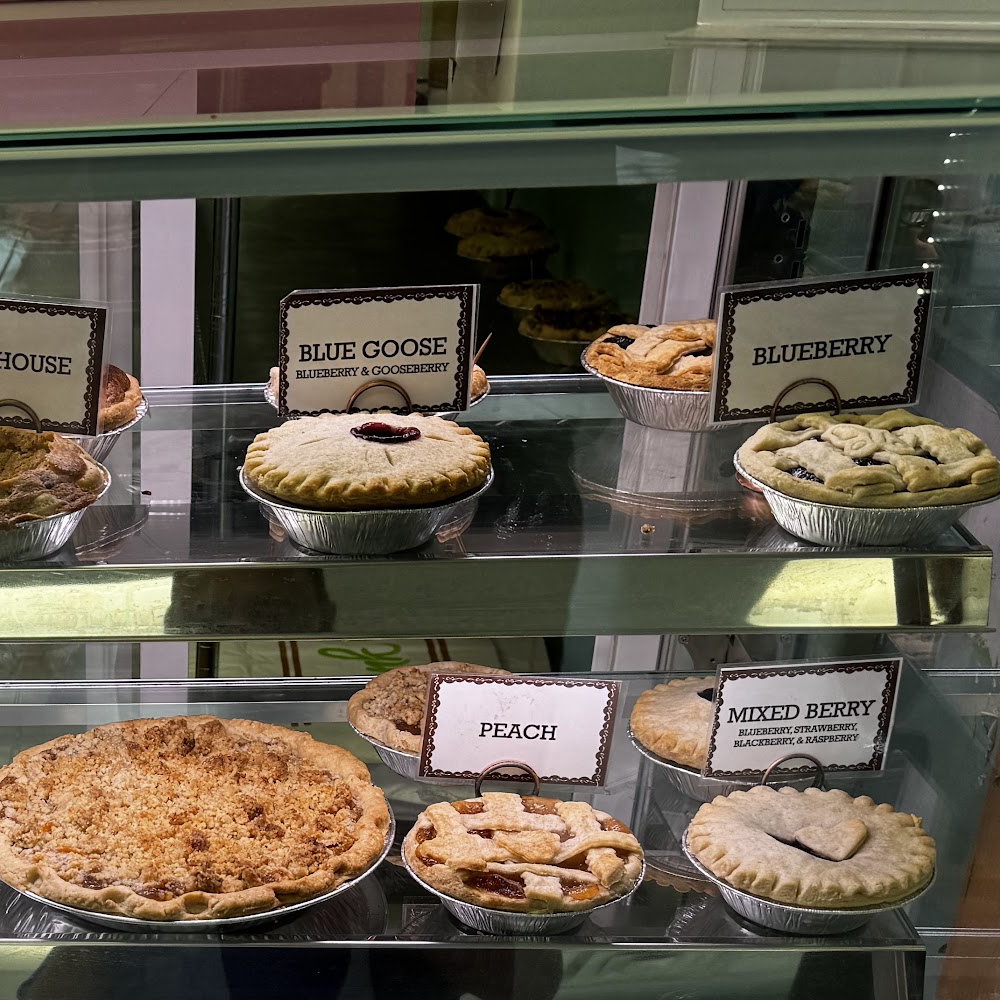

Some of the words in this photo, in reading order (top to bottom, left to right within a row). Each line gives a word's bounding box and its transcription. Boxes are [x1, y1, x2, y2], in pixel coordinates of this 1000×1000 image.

[298, 341, 356, 362] BLUE
[362, 336, 448, 359] GOOSE
[752, 333, 893, 366] BLUEBERRY
[295, 366, 360, 380] BLUEBERRY
[361, 366, 370, 376] &
[371, 362, 450, 376] GOOSEBERRY
[726, 704, 801, 724] MIXED
[804, 700, 876, 719] BERRY
[478, 722, 558, 741] PEACH
[738, 726, 794, 737] BLUEBERRY,
[793, 723, 858, 734] STRAWBERRY,
[733, 737, 795, 748] BLACKBERRY,
[796, 736, 804, 745] &
[805, 733, 860, 744] RASPBERRY
